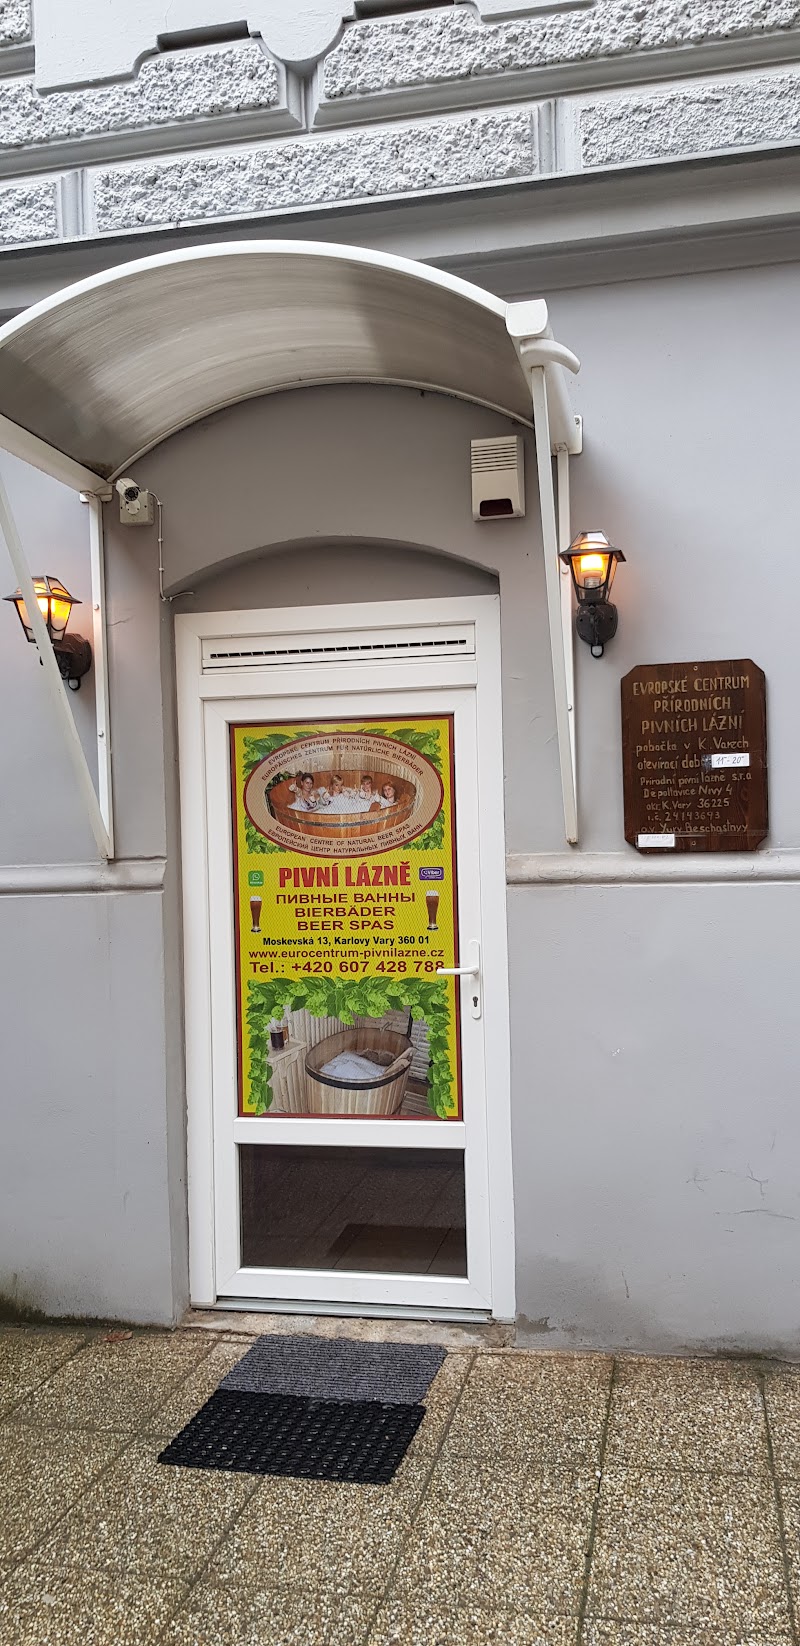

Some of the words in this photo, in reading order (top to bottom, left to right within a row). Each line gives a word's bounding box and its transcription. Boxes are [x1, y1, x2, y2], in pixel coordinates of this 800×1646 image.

[633, 676, 688, 695] EVROPSKÉ
[694, 676, 750, 691] CENTRUM
[654, 694, 731, 713] PŘÍRODNÍCH
[642, 716, 697, 734] PIVNÍCH
[703, 710, 745, 731] LÁZNÍ
[301, 739, 329, 749] CENTRUM
[399, 748, 416, 760] LÁZNÍ
[305, 746, 333, 755] ZENTRUM
[636, 740, 677, 757] pobočka
[638, 756, 679, 770] otevírací
[682, 754, 705, 768] dob
[725, 784, 732, 795] 4
[697, 798, 730, 808] 36225
[276, 826, 306, 841] EUROPEAN
[279, 863, 339, 888] PIVNÍ
[345, 861, 411, 887] LÁZNĚ
[276, 893, 348, 904] ПИВНЫЕ
[353, 892, 415, 903] ВАННЫ
[295, 905, 396, 918] BIERBÄDER
[297, 921, 344, 931] BEER
[350, 920, 394, 930] SPAS
[263, 937, 314, 946] Moskevská
[317, 937, 331, 946] 13,
[334, 936, 370, 946] Karlovy
[373, 936, 395, 946] Vary
[398, 936, 415, 944] 360
[419, 936, 429, 944] 01
[249, 948, 444, 959] www.eurocentrum-pivnilazne.cz
[250, 961, 285, 973] Tel.:
[292, 961, 333, 973] +420
[339, 961, 369, 973] 607
[375, 961, 407, 972] 428
[414, 961, 444, 972] 788
